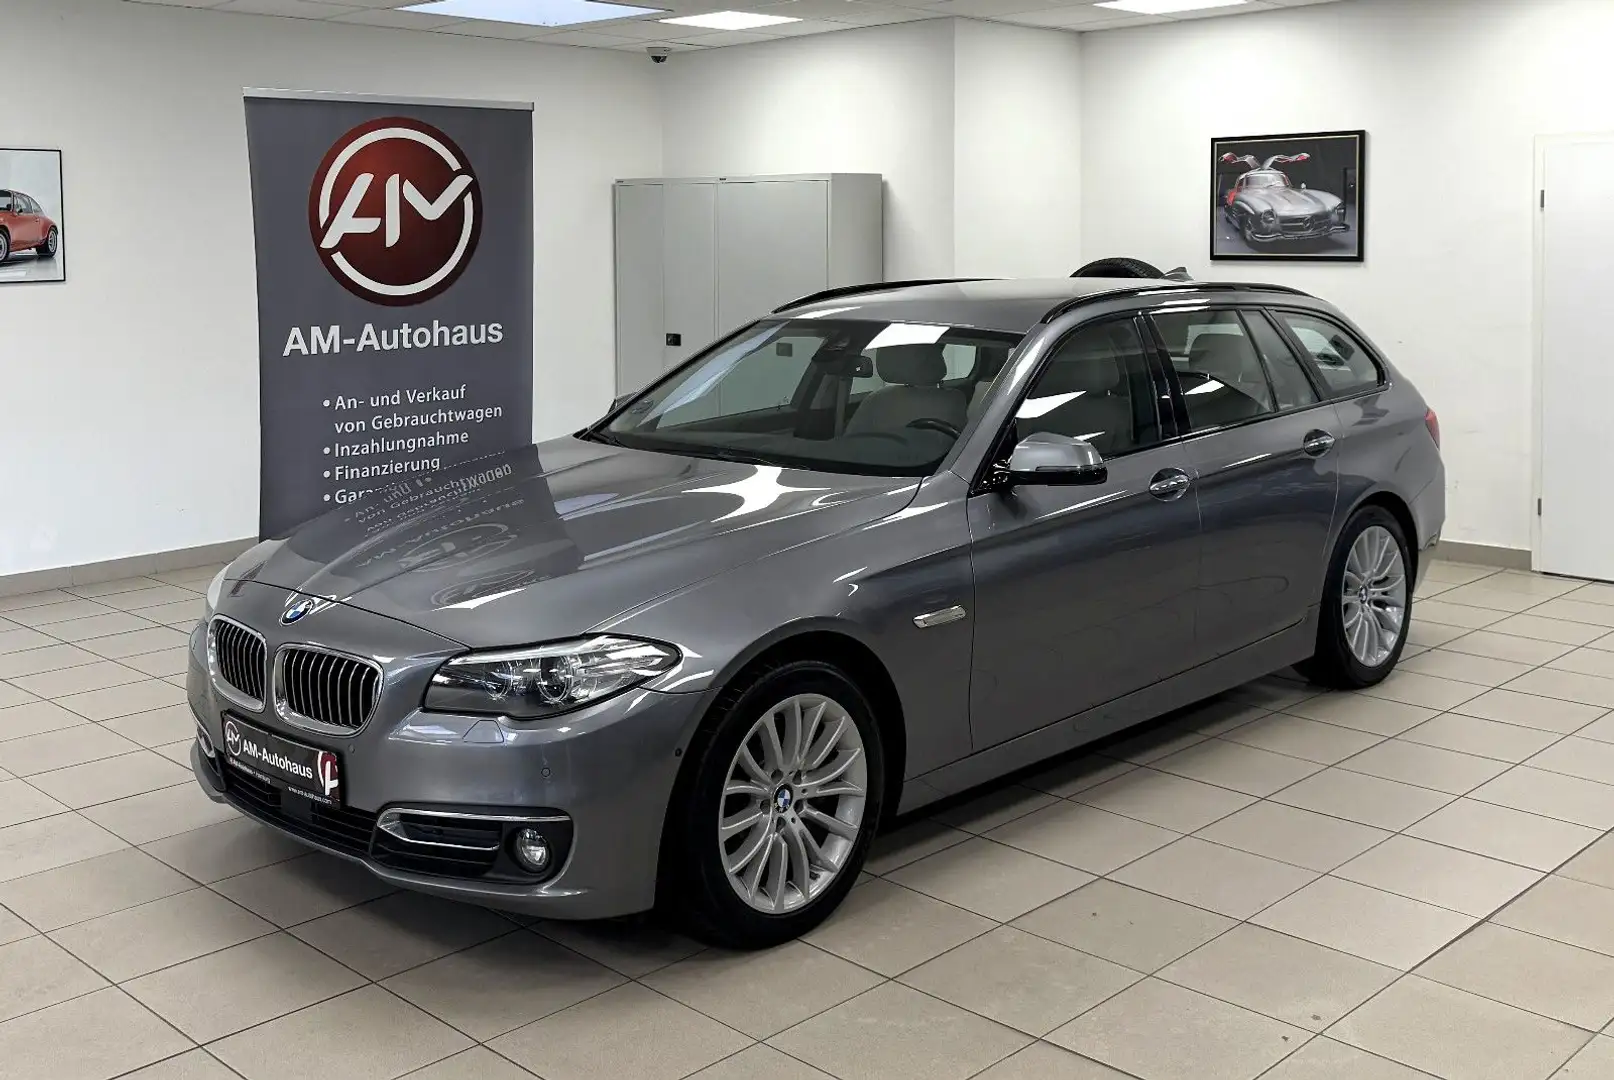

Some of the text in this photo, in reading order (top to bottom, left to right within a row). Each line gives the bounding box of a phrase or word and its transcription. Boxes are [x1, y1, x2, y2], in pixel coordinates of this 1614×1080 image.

[320, 173, 473, 248] AM
[282, 319, 504, 357] AM-Autohaus
[334, 384, 467, 410] An- und Verkauf
[334, 406, 503, 434] von Gebrauchtwagen
[334, 431, 469, 457] Inzahlungnahme
[334, 457, 441, 480] Finanzierung
[243, 739, 314, 779] AM-Autohaus
